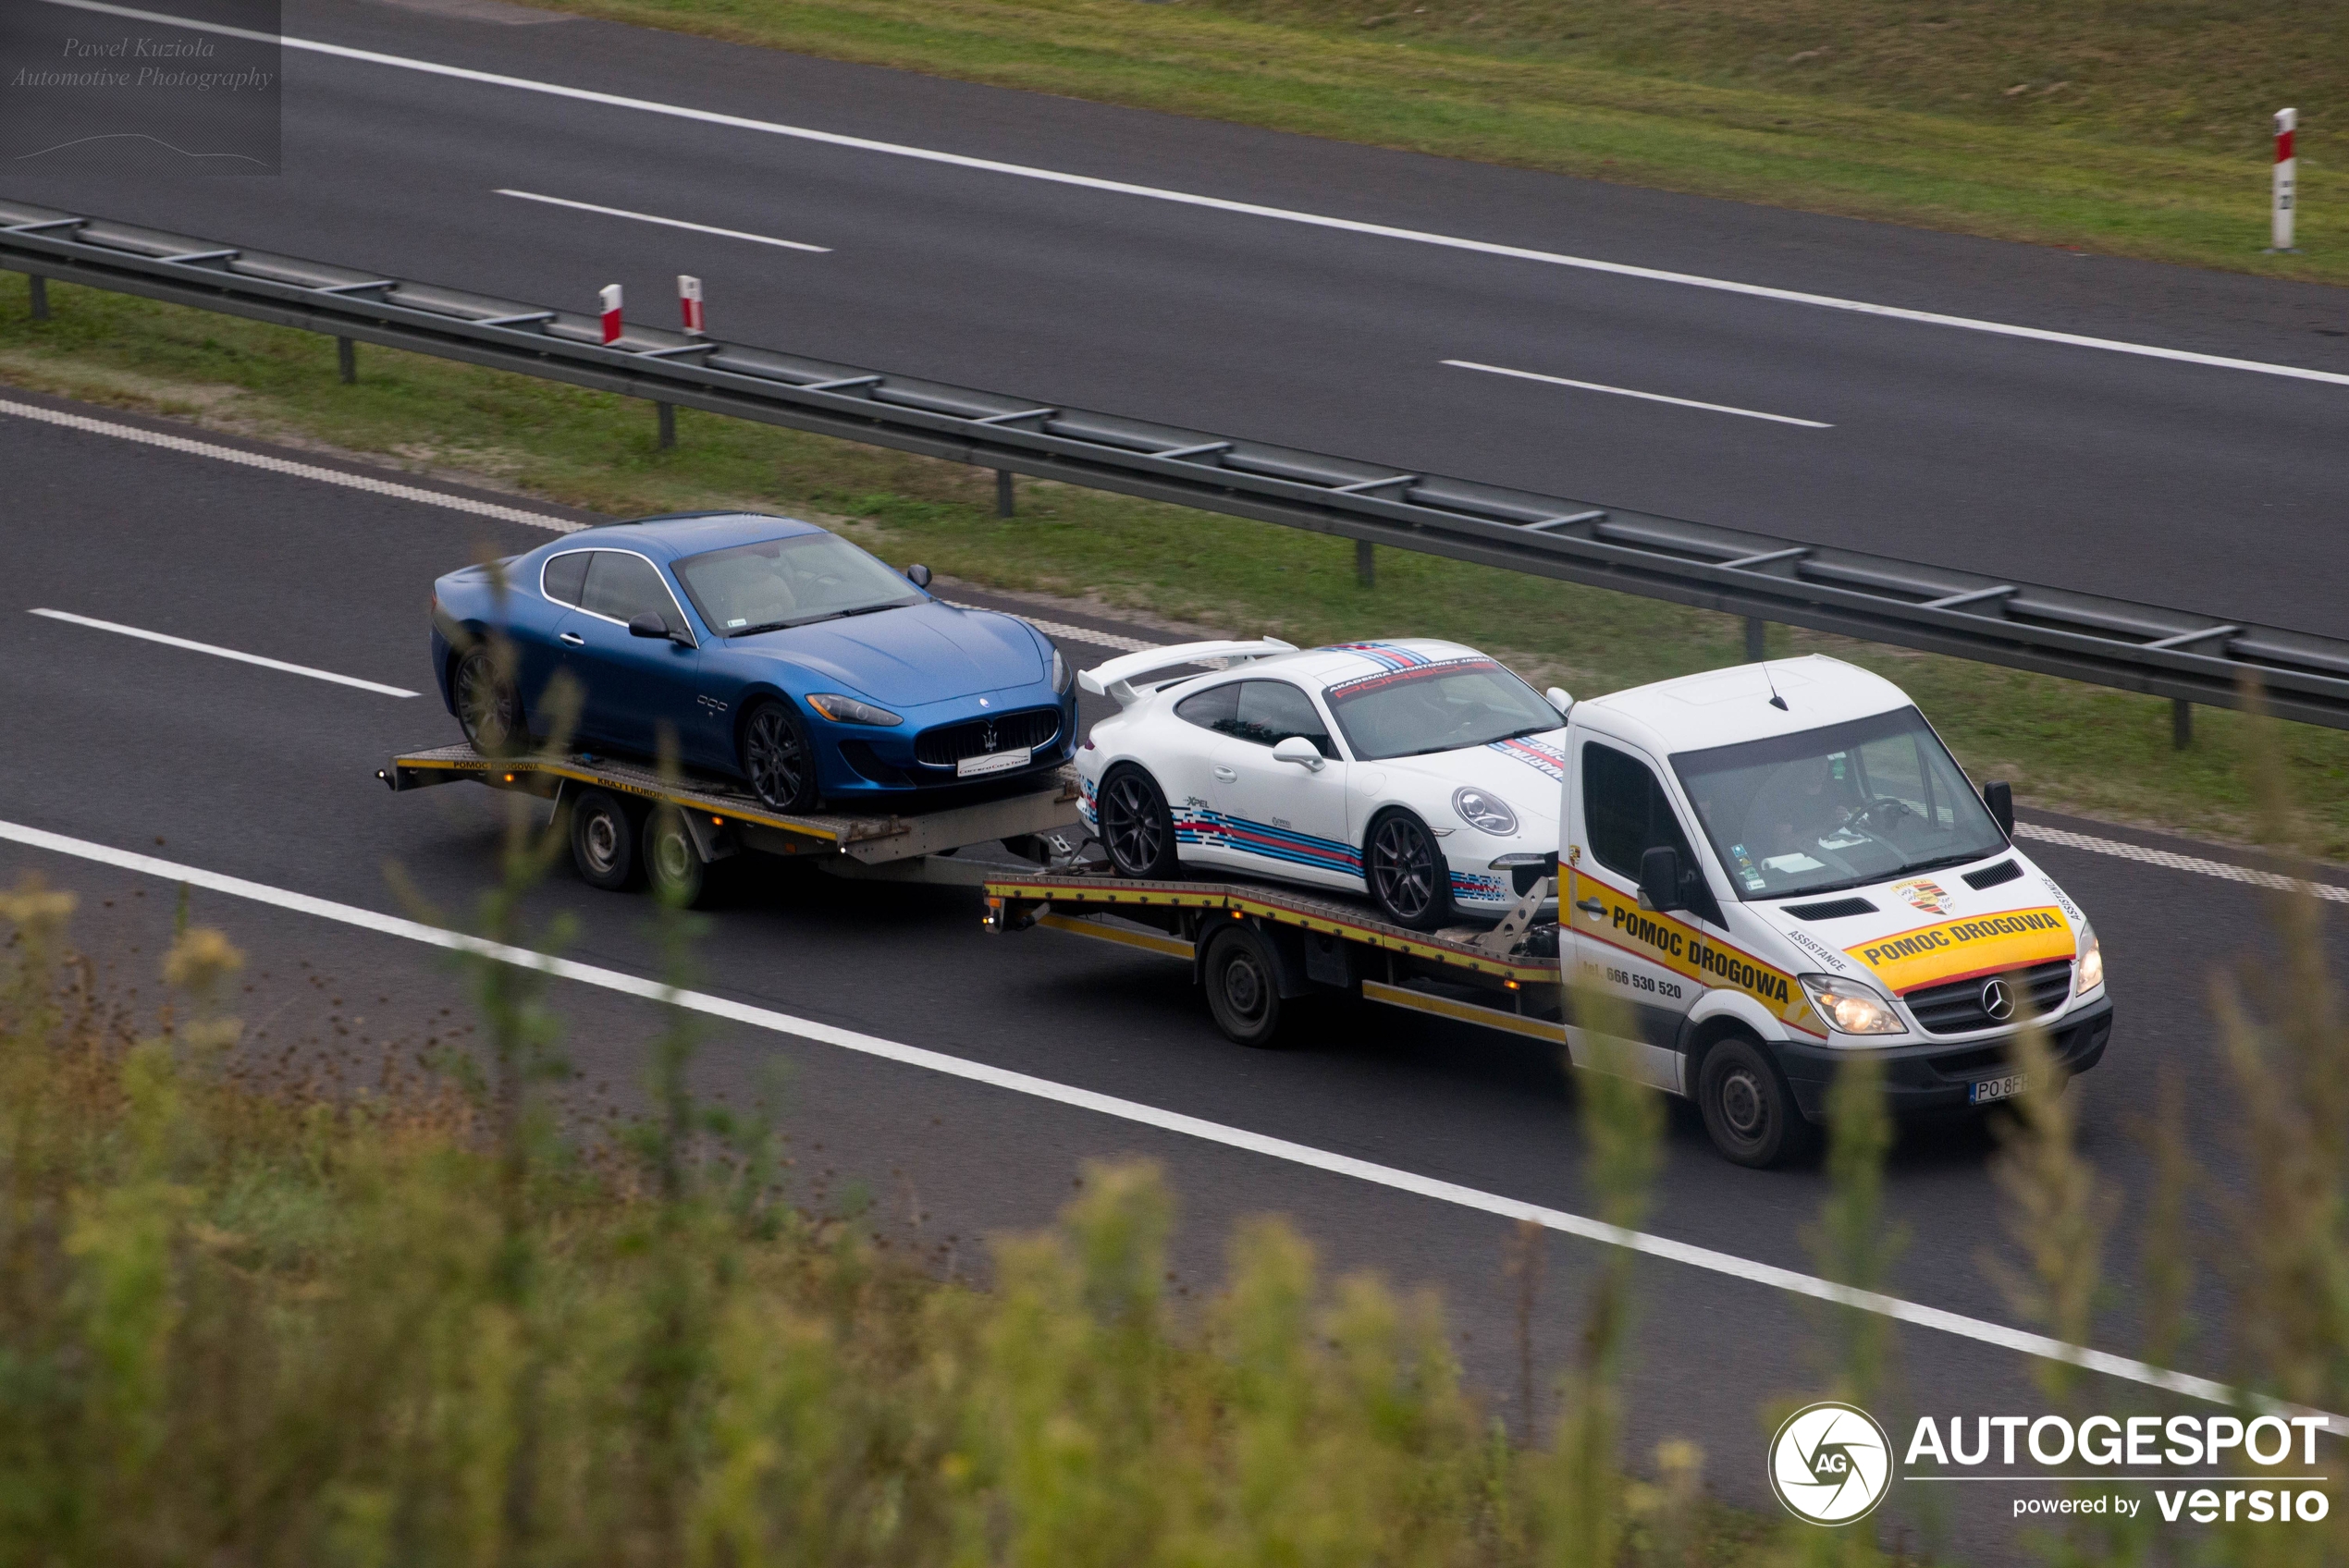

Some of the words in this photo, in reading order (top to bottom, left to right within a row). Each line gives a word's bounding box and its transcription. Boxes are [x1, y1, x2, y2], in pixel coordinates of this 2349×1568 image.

[1329, 672, 1392, 692] AKADEMIA
[1393, 659, 1457, 674] SPORTOWEJ
[1334, 662, 1497, 698] PORSCHE
[453, 761, 488, 769] POMOC
[597, 778, 622, 790] KRAJ
[1187, 795, 1210, 809] XPEL
[2041, 877, 2082, 921] ASSISTANCE
[1612, 904, 1682, 957] POMOC
[1688, 939, 1789, 1005] DROGOWA
[1788, 930, 1847, 972] ASSISTANCE
[1863, 930, 1949, 966] POMOC
[1949, 913, 2062, 942] DROGOWA
[1606, 967, 1630, 986] 666
[1632, 974, 1655, 993] 530
[1658, 981, 1682, 999] 520
[1977, 1081, 1999, 1099] PO
